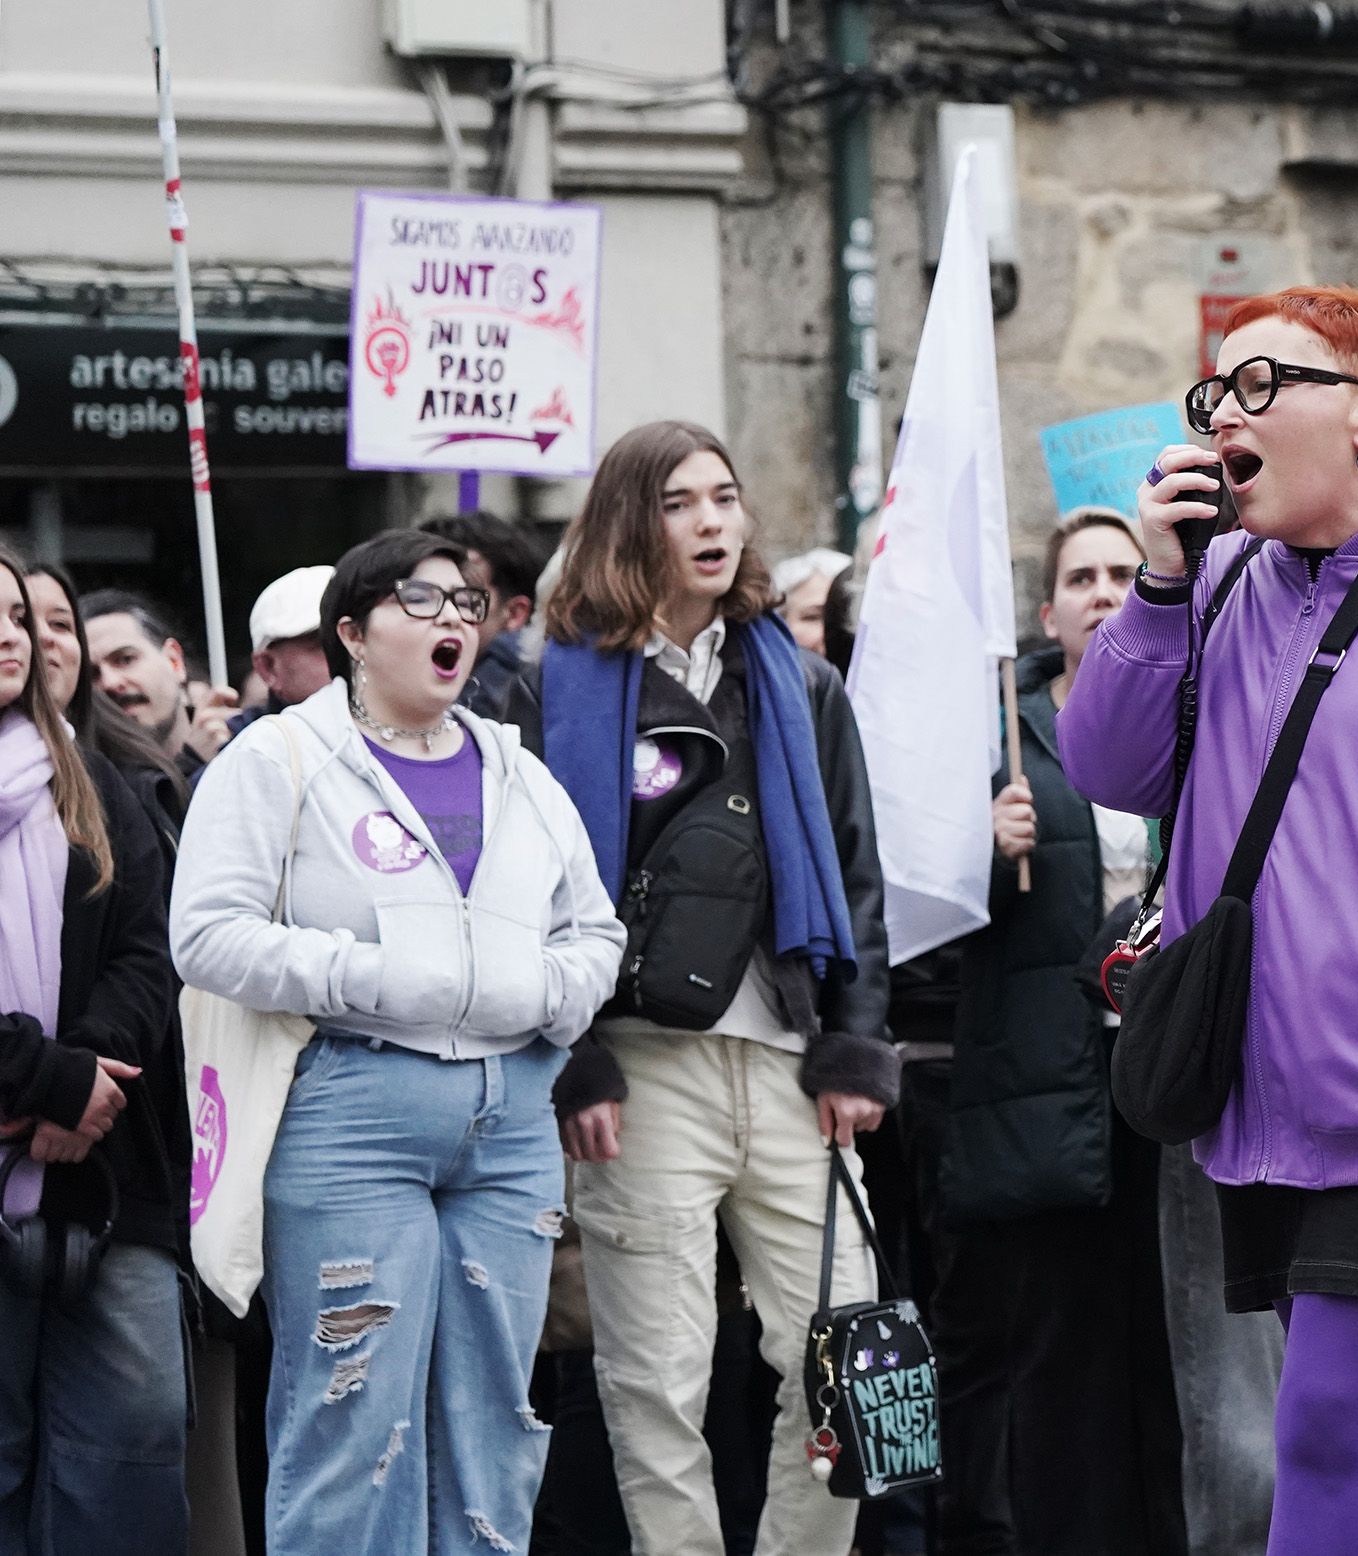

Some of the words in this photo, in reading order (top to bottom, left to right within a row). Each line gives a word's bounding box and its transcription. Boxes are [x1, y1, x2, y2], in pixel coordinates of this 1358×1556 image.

[389, 217, 460, 249] SIGAMOS
[477, 323, 510, 349] UN
[440, 354, 504, 383] PASO
[853, 1362, 936, 1412] NEVER
[862, 1396, 936, 1442] TRUST
[864, 1420, 940, 1480] LIVING
